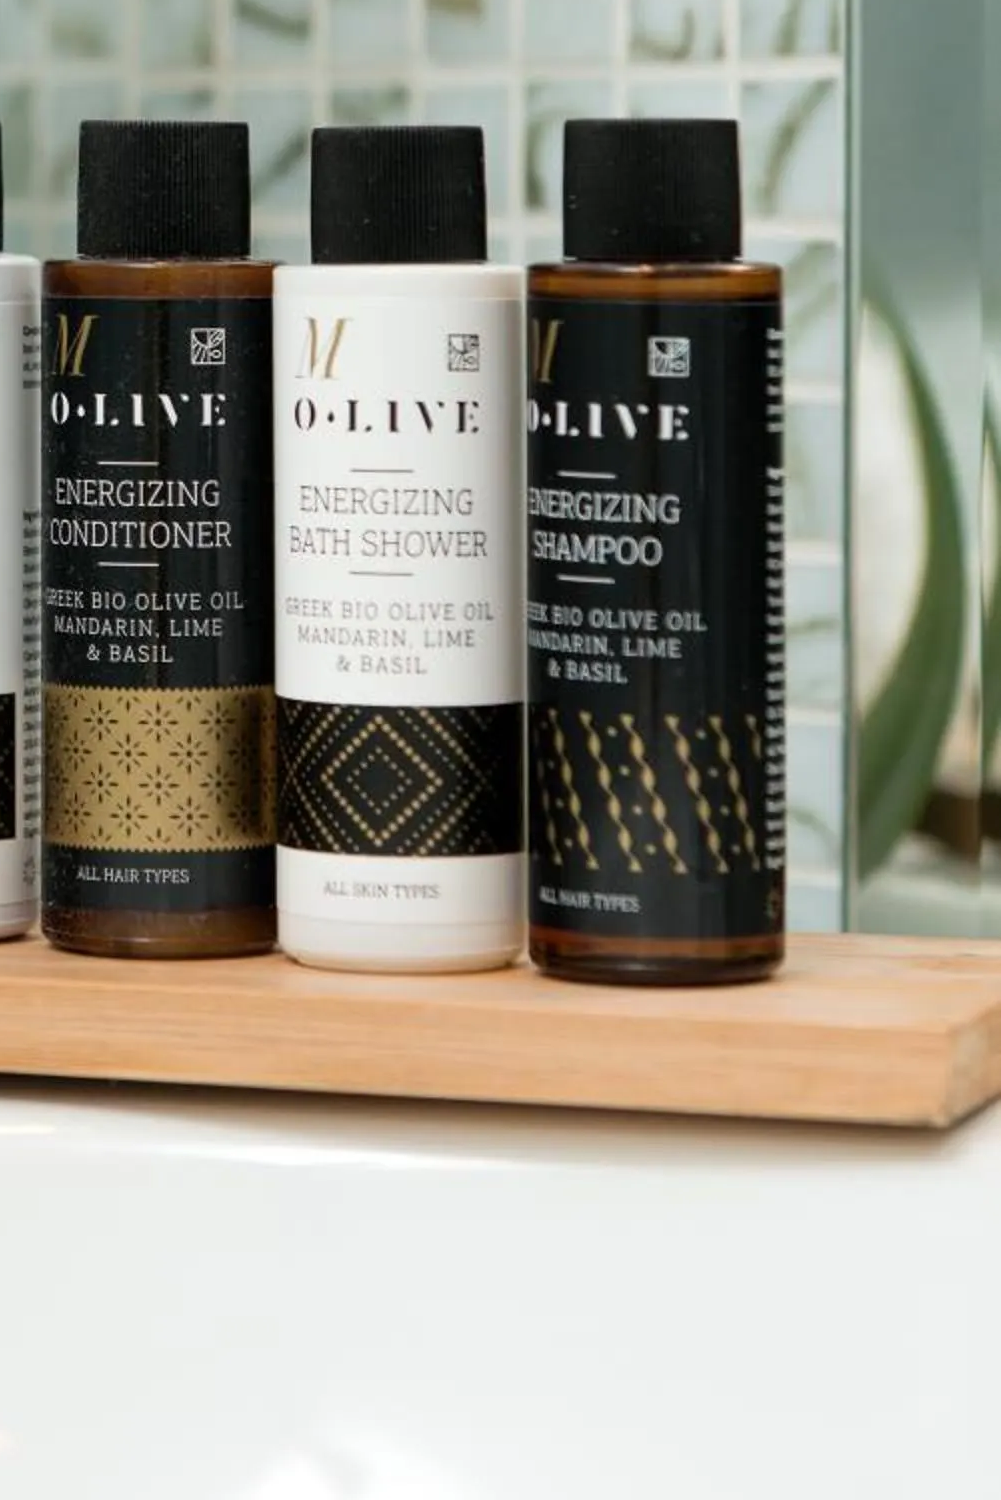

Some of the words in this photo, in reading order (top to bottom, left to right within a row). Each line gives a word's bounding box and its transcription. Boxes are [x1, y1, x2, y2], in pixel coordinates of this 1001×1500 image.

[51, 314, 99, 376] M
[295, 317, 353, 379] M
[55, 477, 220, 508] ENERGIZING
[300, 485, 473, 515] ENERGIZING
[528, 487, 682, 525] ENERGIZING
[50, 519, 232, 548] CONDITIONER
[289, 525, 350, 556] BATH
[361, 530, 488, 557] SHOWER
[533, 530, 663, 566] SHAMPOO
[91, 591, 126, 609] BIO
[135, 593, 202, 610] OLIVE
[210, 591, 244, 609] OIL
[285, 596, 333, 618] GREEK
[341, 600, 378, 620] BIO
[389, 603, 456, 621] OLIVE
[463, 603, 494, 621] OIL
[54, 615, 160, 639] MANDARIN,
[170, 619, 224, 637] LIME
[550, 605, 583, 627] BIO
[588, 609, 657, 631] OLIVE
[664, 610, 707, 632] OIL
[297, 625, 415, 647] MANDARIN,
[424, 630, 476, 648] LIME
[621, 637, 682, 659] LIME
[87, 644, 100, 662] &
[109, 645, 174, 663] BASIL
[336, 656, 351, 673] &
[360, 656, 428, 675] BASIL
[548, 657, 561, 678] &
[565, 660, 629, 684] BASIL
[77, 867, 100, 881] ALL
[104, 868, 139, 883] HAIR
[144, 869, 190, 884] TYPES
[323, 881, 349, 896] ALL
[352, 883, 388, 898] SKIN
[392, 884, 441, 899] TYPES
[539, 886, 556, 905] ALL
[559, 891, 591, 910] HAIR
[594, 894, 641, 913] TYPES
